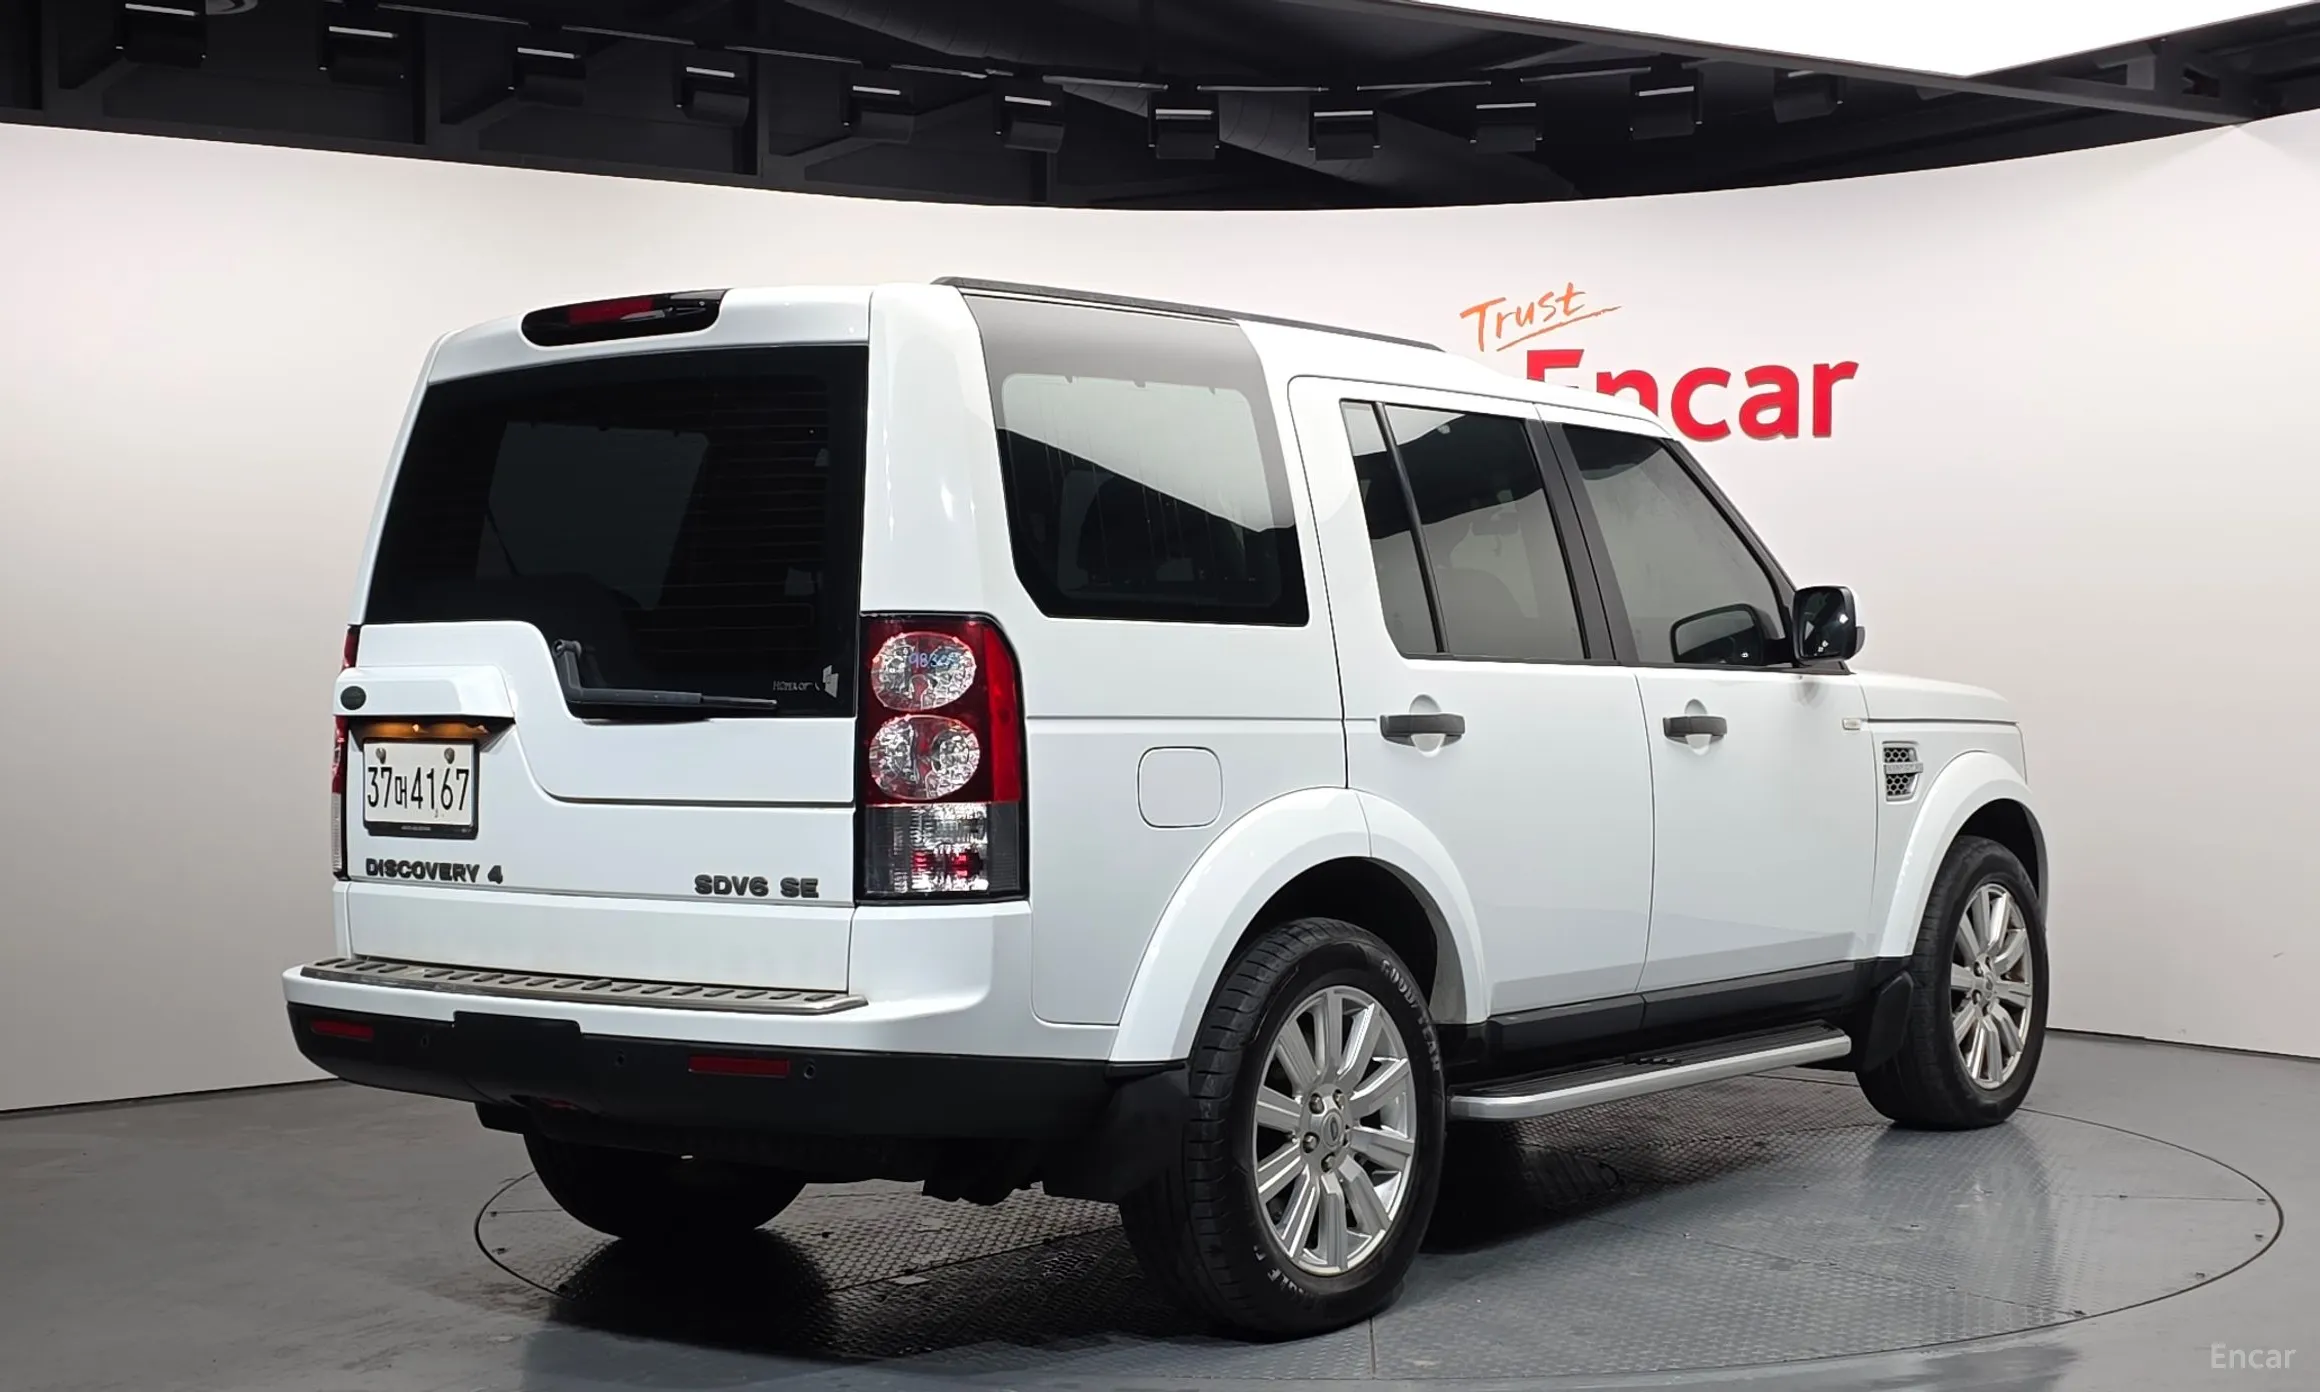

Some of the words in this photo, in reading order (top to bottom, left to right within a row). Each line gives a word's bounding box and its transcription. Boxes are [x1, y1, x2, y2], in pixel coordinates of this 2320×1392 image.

[1459, 282, 1587, 352] Trust
[366, 858, 480, 883] DISCOVERY
[487, 865, 504, 884] 4
[695, 874, 769, 897] SDV6
[780, 876, 819, 899] SE
